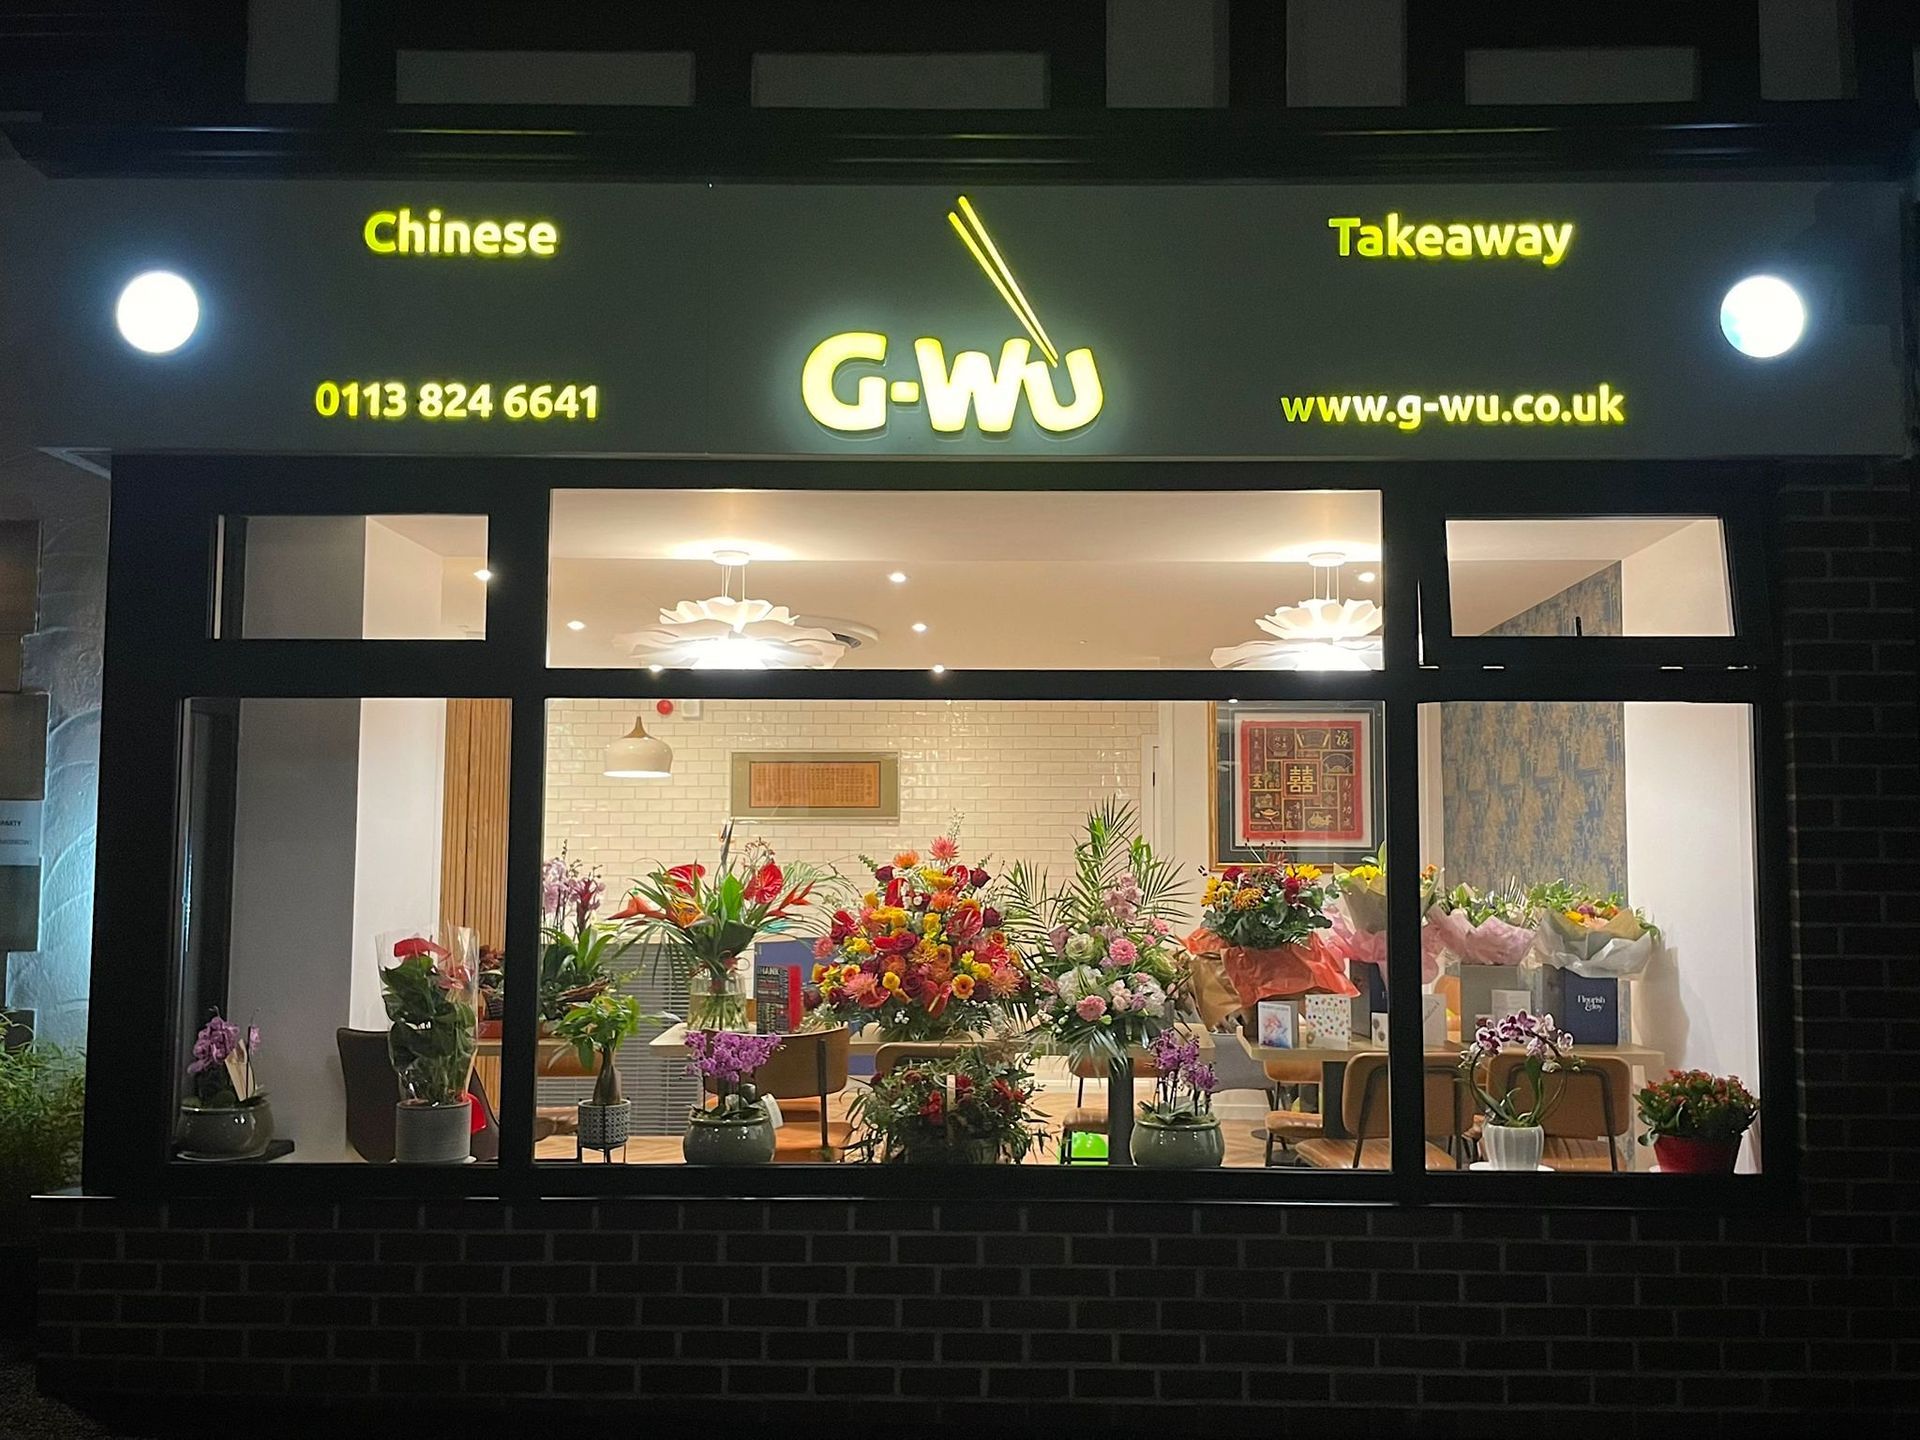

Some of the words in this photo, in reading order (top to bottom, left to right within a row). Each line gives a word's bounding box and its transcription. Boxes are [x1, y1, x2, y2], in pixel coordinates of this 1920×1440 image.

[364, 208, 558, 255] Chinese
[1328, 212, 1574, 266] Takeaway
[315, 381, 407, 418] 0113
[418, 382, 494, 418] 824
[503, 384, 598, 420] 6641
[1280, 383, 1625, 430] www.g-wu.co.uk
